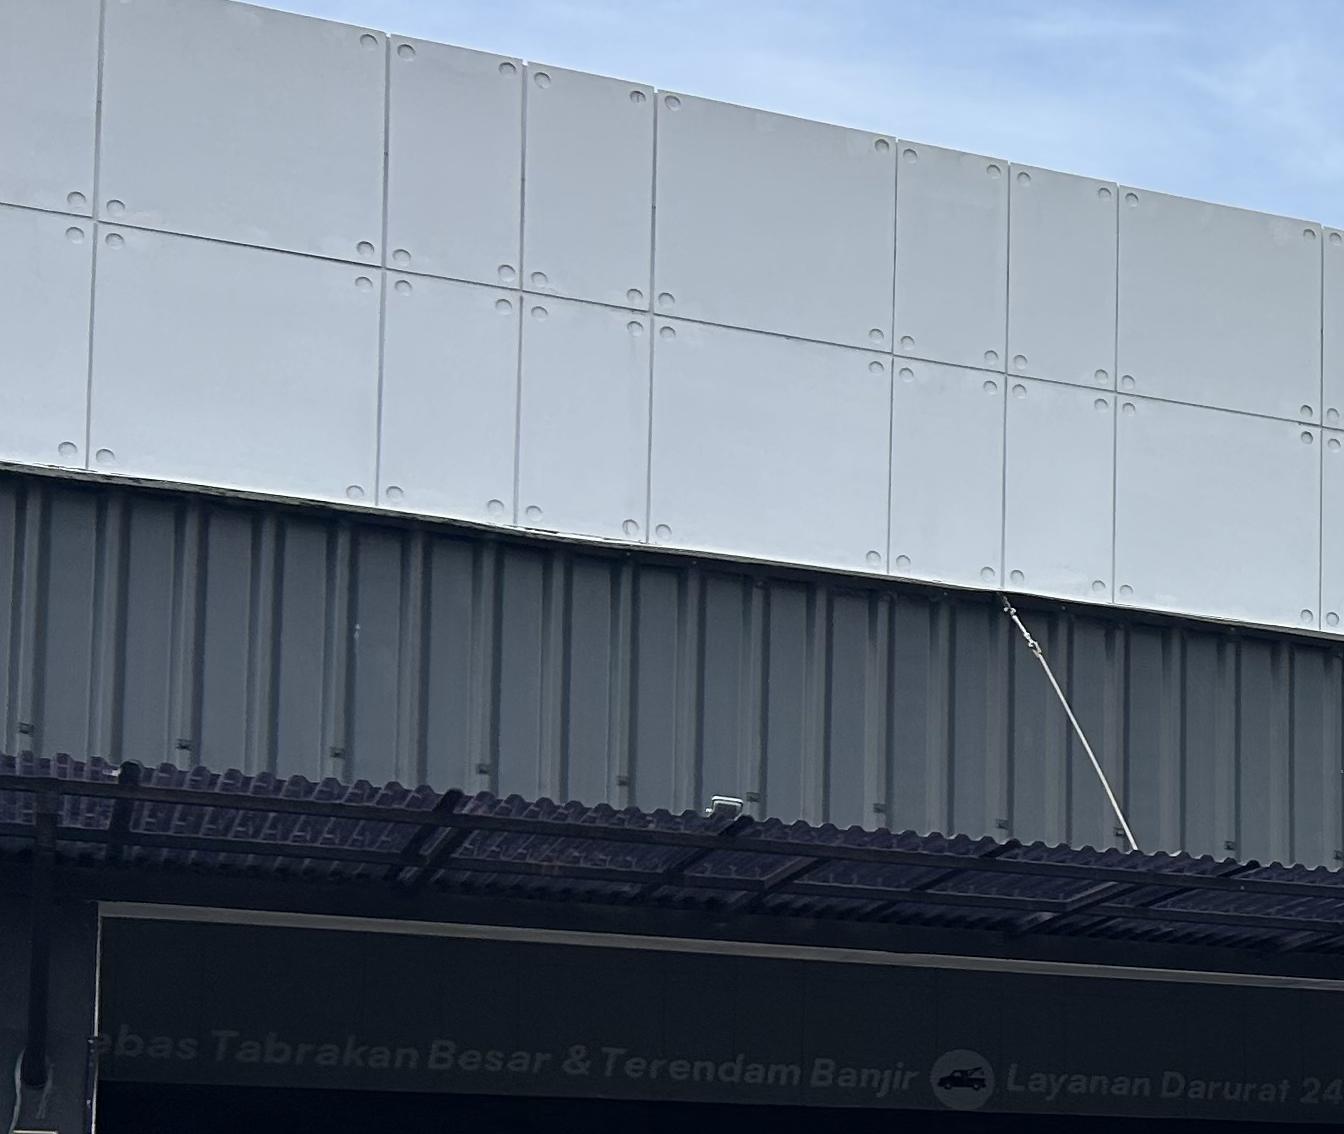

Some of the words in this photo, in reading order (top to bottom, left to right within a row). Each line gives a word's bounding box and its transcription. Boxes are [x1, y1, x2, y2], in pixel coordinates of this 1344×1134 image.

[210, 1028, 419, 1069] Tabrakan
[426, 1038, 552, 1074] Besar
[560, 1043, 592, 1076] &
[600, 1046, 802, 1087] Terendam
[809, 1056, 919, 1098] Banjir
[1006, 1063, 1152, 1101] Layanan
[1159, 1071, 1292, 1103] Darurat
[1300, 1076, 1342, 1105] 24
